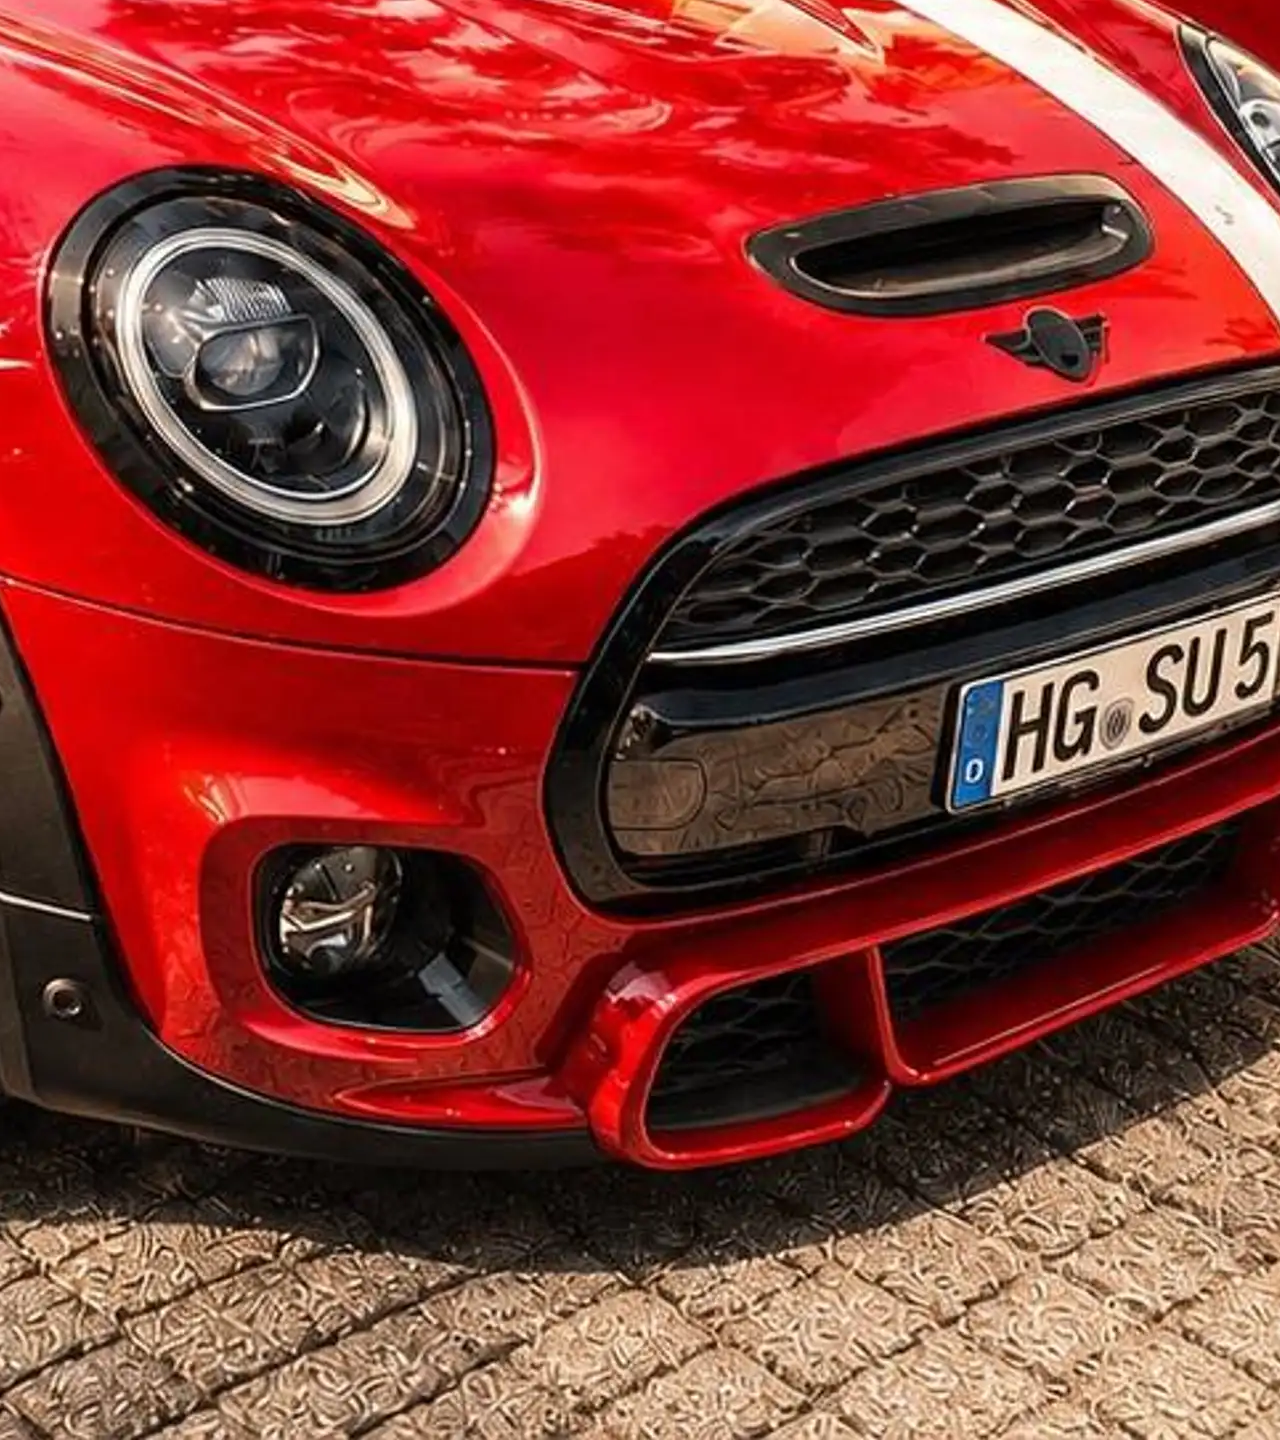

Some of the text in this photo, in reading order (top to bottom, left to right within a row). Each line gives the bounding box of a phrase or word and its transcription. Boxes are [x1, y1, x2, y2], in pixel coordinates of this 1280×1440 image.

[1001, 611, 1275, 782] HG SU 5
